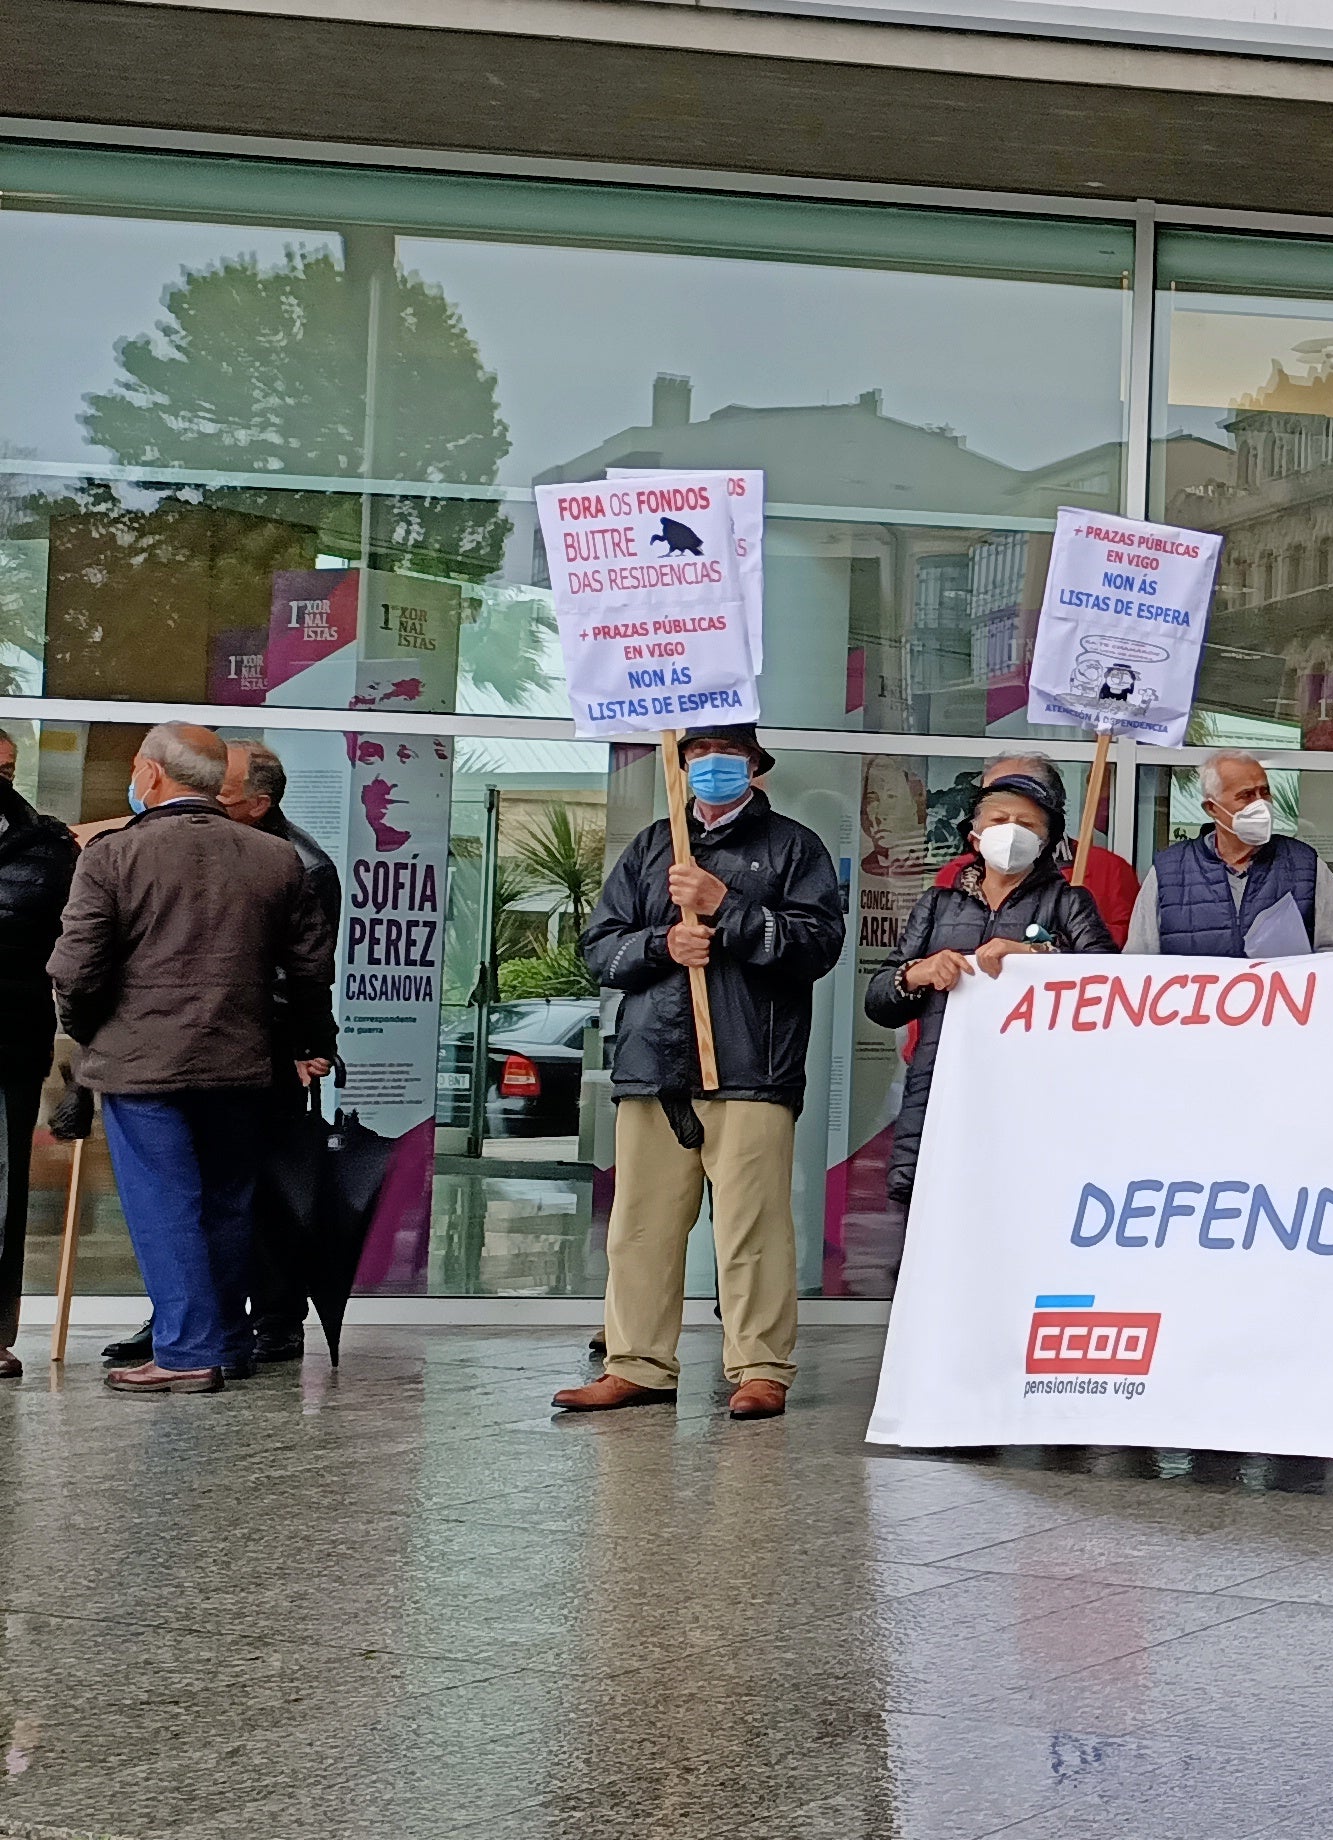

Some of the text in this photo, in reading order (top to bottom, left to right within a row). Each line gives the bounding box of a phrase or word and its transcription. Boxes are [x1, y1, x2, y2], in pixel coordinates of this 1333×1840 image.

[558, 495, 606, 521] FORA
[609, 492, 632, 517] OS
[636, 486, 711, 514] FONDOS
[563, 526, 638, 563] BUITRE
[1085, 526, 1136, 548] PRAZAS
[1138, 532, 1200, 559] PÚBLICAS
[1106, 549, 1160, 571] EN VIGO
[568, 560, 722, 595] DAS RESIDENCIAS
[1102, 571, 1158, 597] NON ÁS
[1059, 588, 1191, 628] LISTAS DE ESPERA
[592, 621, 650, 641] PRAZAS
[653, 614, 727, 636] PÚBLICAS
[623, 641, 686, 661] EN VIGO
[627, 661, 692, 690] NON ÁS
[587, 689, 742, 721] LISTAS DE ESPERA
[351, 853, 438, 913] SOFÍA
[347, 906, 437, 968] PÉREZ
[345, 973, 433, 1002] CASANOVA
[1001, 961, 1317, 1035] ATENCIÓN
[1032, 1326, 1147, 1361] CCOO
[1024, 1376, 1146, 1401] pensionistas vigo
